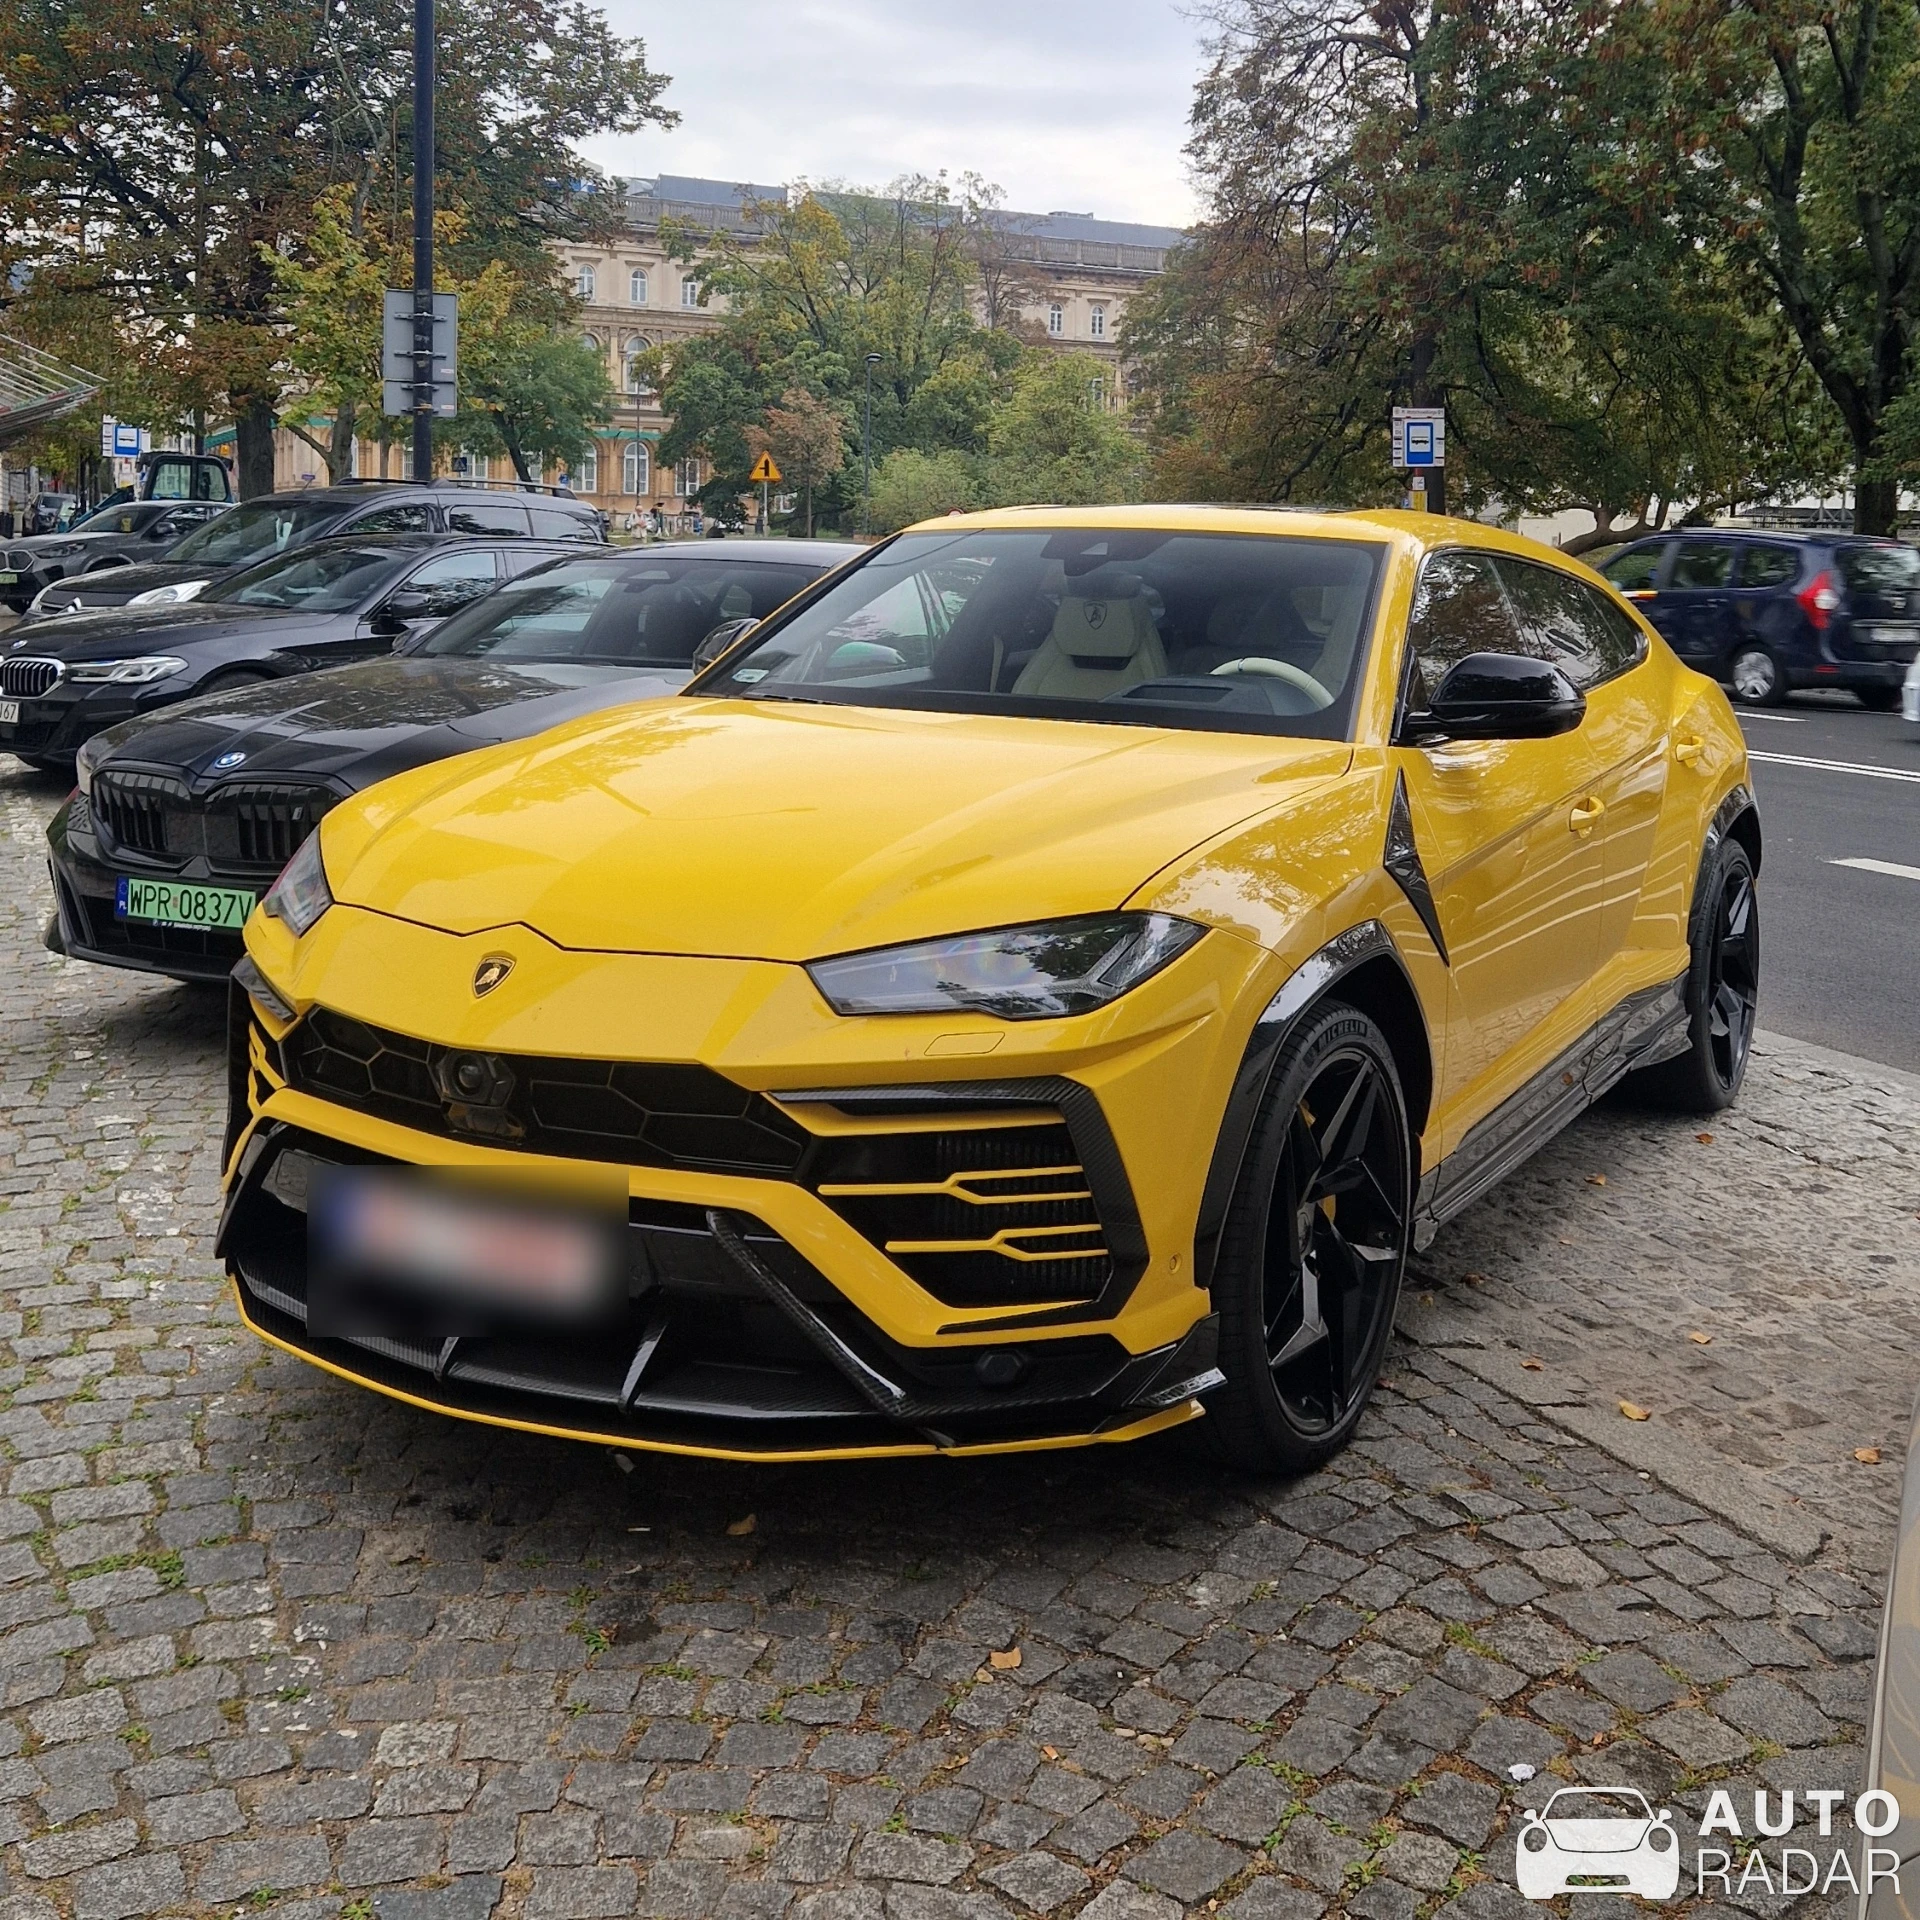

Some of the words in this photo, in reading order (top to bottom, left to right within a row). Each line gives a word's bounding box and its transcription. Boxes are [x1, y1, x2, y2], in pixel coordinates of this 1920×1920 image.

[0, 702, 17, 719] 67
[119, 900, 127, 910] PL
[130, 883, 171, 918] WPR
[179, 889, 253, 925] 0837V
[1319, 1020, 1366, 1049] MICHELIN
